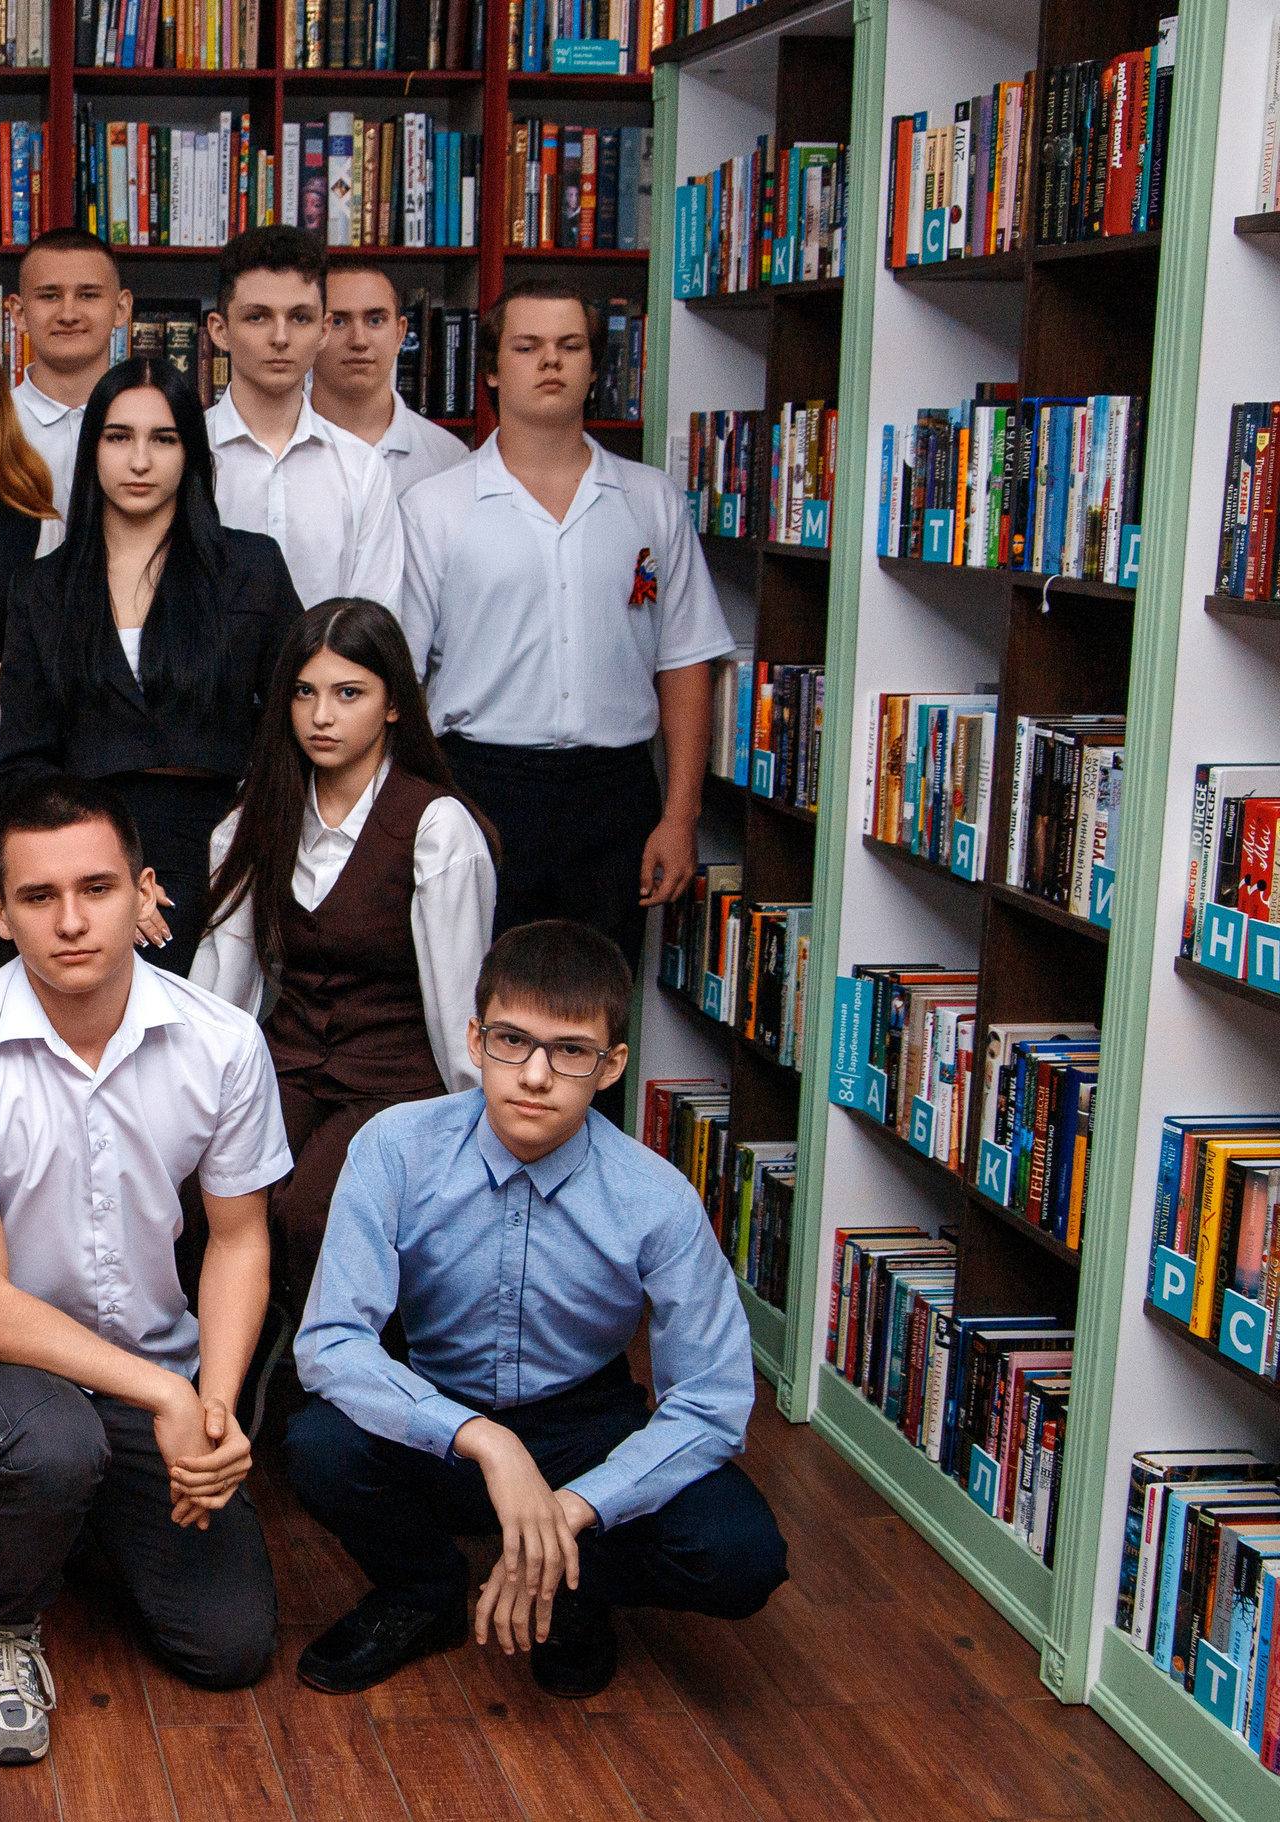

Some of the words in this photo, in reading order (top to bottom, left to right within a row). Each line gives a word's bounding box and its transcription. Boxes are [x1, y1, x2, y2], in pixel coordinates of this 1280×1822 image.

[1113, 61, 1128, 121] Вердон
[1044, 90, 1057, 134] океан
[1266, 120, 1275, 137] ЛИ
[953, 125, 967, 163] 2017
[1110, 122, 1124, 169] Джон
[1149, 157, 1163, 214] ТРИПТИХ
[1260, 142, 1274, 195] МАУРИН
[926, 218, 941, 253] С
[692, 263, 702, 289] А
[775, 246, 787, 276] К
[994, 429, 1006, 463] ТРАУБ
[1270, 416, 1279, 444] МЕЧТЫ
[1002, 429, 1017, 481] ТРАУБ
[1021, 450, 1031, 480] БРАУН
[1266, 444, 1277, 484] ПРИВОДЯТ
[890, 492, 898, 521] САПОГА
[1002, 481, 1012, 510] МАША
[1222, 483, 1234, 533] ХРАНИТЕЛЬ
[1239, 471, 1250, 515] КУЗЕНЫ
[1264, 484, 1273, 506] КУДА
[723, 501, 733, 529] В
[791, 497, 804, 533] АСАН
[805, 509, 824, 539] М
[1101, 497, 1109, 528] ГОРОД
[1251, 513, 1259, 532] чая
[929, 519, 945, 552] Т
[1098, 530, 1107, 573] ЖЕНЩИН
[1261, 517, 1269, 554] Матесон
[1258, 553, 1267, 583] Ричард
[1013, 742, 1024, 777] ЛЮДИ
[1081, 757, 1092, 798] ЗУСАК
[1011, 780, 1020, 805] ЧЕМ
[1088, 757, 1100, 801] МАРКУС
[1009, 807, 1019, 851] ЛУЧШЕ,
[1225, 804, 1236, 838] Полиция
[955, 833, 971, 869] Я
[1075, 812, 1090, 870] ГЛИНЯНЫЙ
[1203, 833, 1212, 850] Ю
[1073, 870, 1084, 902] МОСТ
[1181, 860, 1199, 939] Королевство
[1191, 829, 1203, 847] Ю
[1200, 850, 1210, 891] головами
[1199, 891, 1206, 902] за
[1209, 917, 1236, 962] Н
[852, 981, 863, 1011] проза
[836, 1003, 848, 1070] Современная
[848, 1013, 861, 1073] Зарубежная
[838, 1077, 855, 1102] 84
[866, 1078, 881, 1112] А
[1008, 1075, 1018, 1103] ТАМ,
[914, 1107, 928, 1143] Б
[1007, 1106, 1016, 1128] ГДЕ
[1035, 1085, 1045, 1131] ДЖЕССИ
[1047, 1124, 1055, 1138] ОН
[984, 1152, 1001, 1192] К
[1029, 1136, 1046, 1202] ГЕНИЙ
[1042, 1138, 1054, 1187] СКАЗАЛ/ОНА
[1041, 1187, 1050, 1221] СКАЗАЛА
[1202, 1174, 1214, 1213] РОУЛИНГ
[1159, 1191, 1172, 1244] РАКУШЕК
[1219, 1187, 1236, 1252] ЧЕРНОЕ
[1162, 1261, 1186, 1302] Р
[1228, 1310, 1254, 1355] С
[928, 1349, 945, 1435] СУБМАРИНА
[1024, 1393, 1042, 1456] Последняя
[1021, 1456, 1035, 1488] улика
[1163, 1503, 1181, 1551] Николас
[1139, 1557, 1150, 1588] тегерана
[1216, 1540, 1230, 1609] постарайся
[1137, 1587, 1147, 1612] крыши
[1223, 1597, 1233, 1614] не
[1205, 1658, 1228, 1705] Т
[1256, 1651, 1269, 1693] МИЛЫЕ
[1251, 1700, 1263, 1739] КОСТИ
